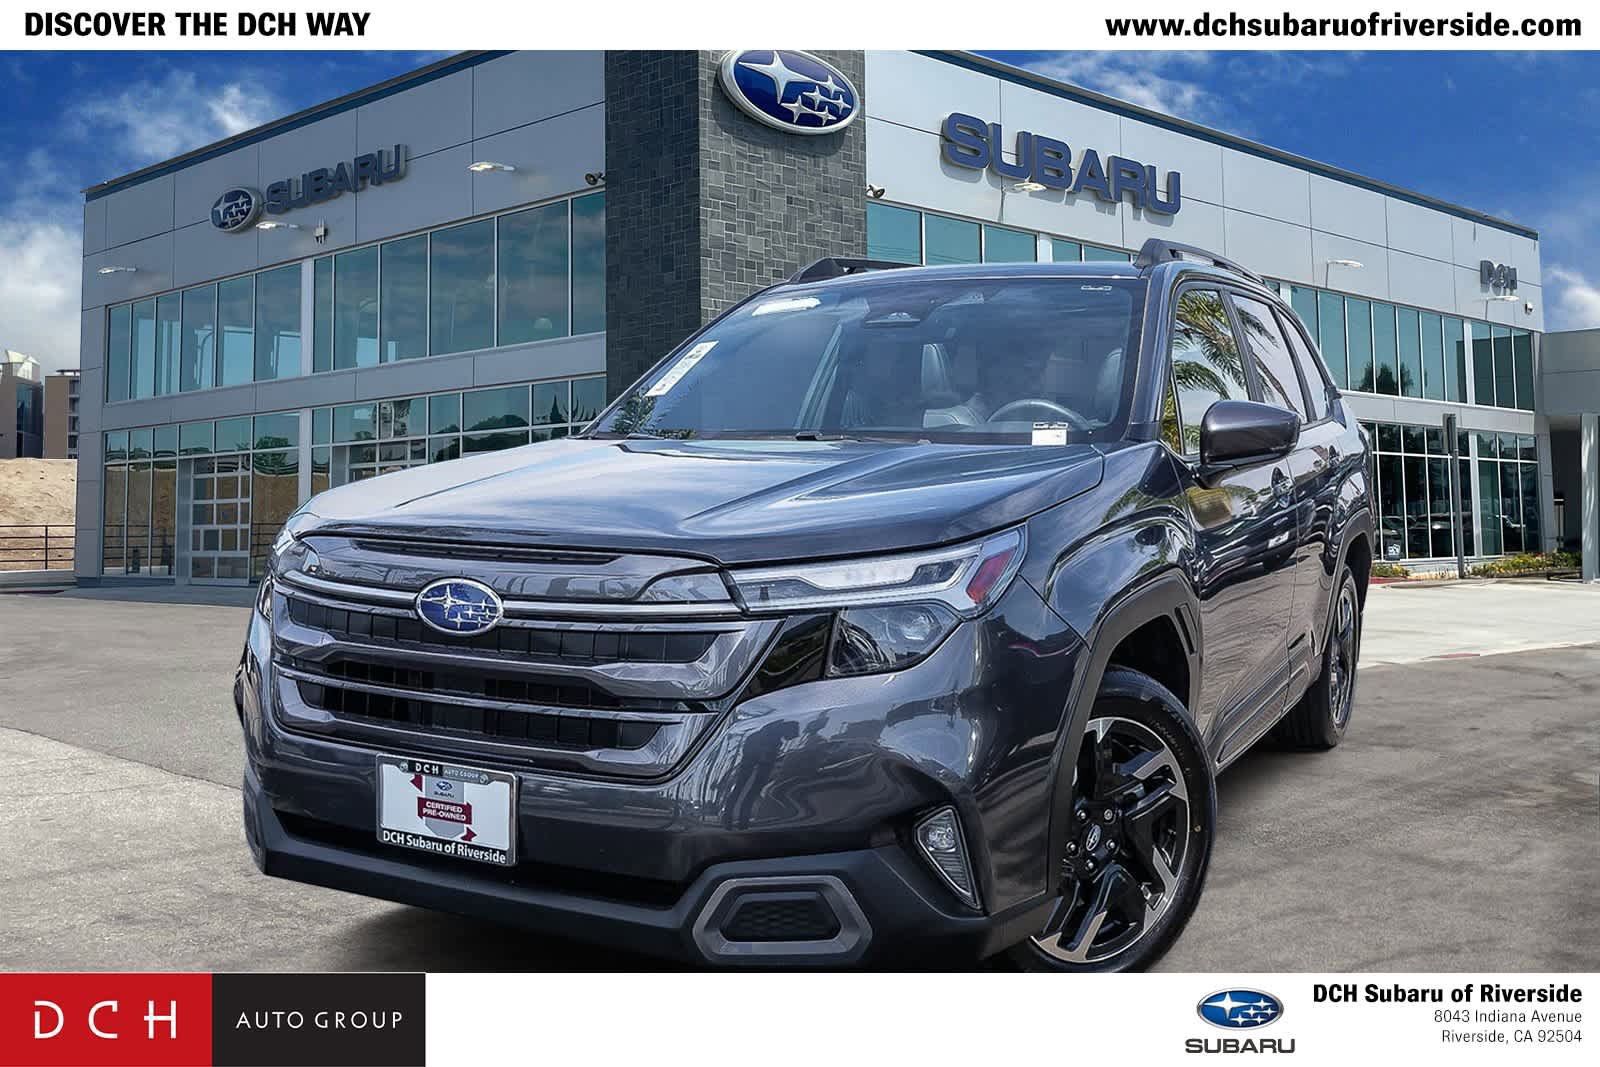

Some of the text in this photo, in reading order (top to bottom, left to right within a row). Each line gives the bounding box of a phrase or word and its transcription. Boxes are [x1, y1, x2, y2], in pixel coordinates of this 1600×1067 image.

[940, 112, 1182, 215] SUBARU
[265, 144, 406, 214] SUBARU
[1480, 260, 1518, 290] DCH
[415, 762, 439, 775] DCH
[422, 807, 467, 822] PRE-OWNED
[425, 801, 463, 814] CERTIFIED
[383, 829, 507, 864] DCH Subaru of Riverside
